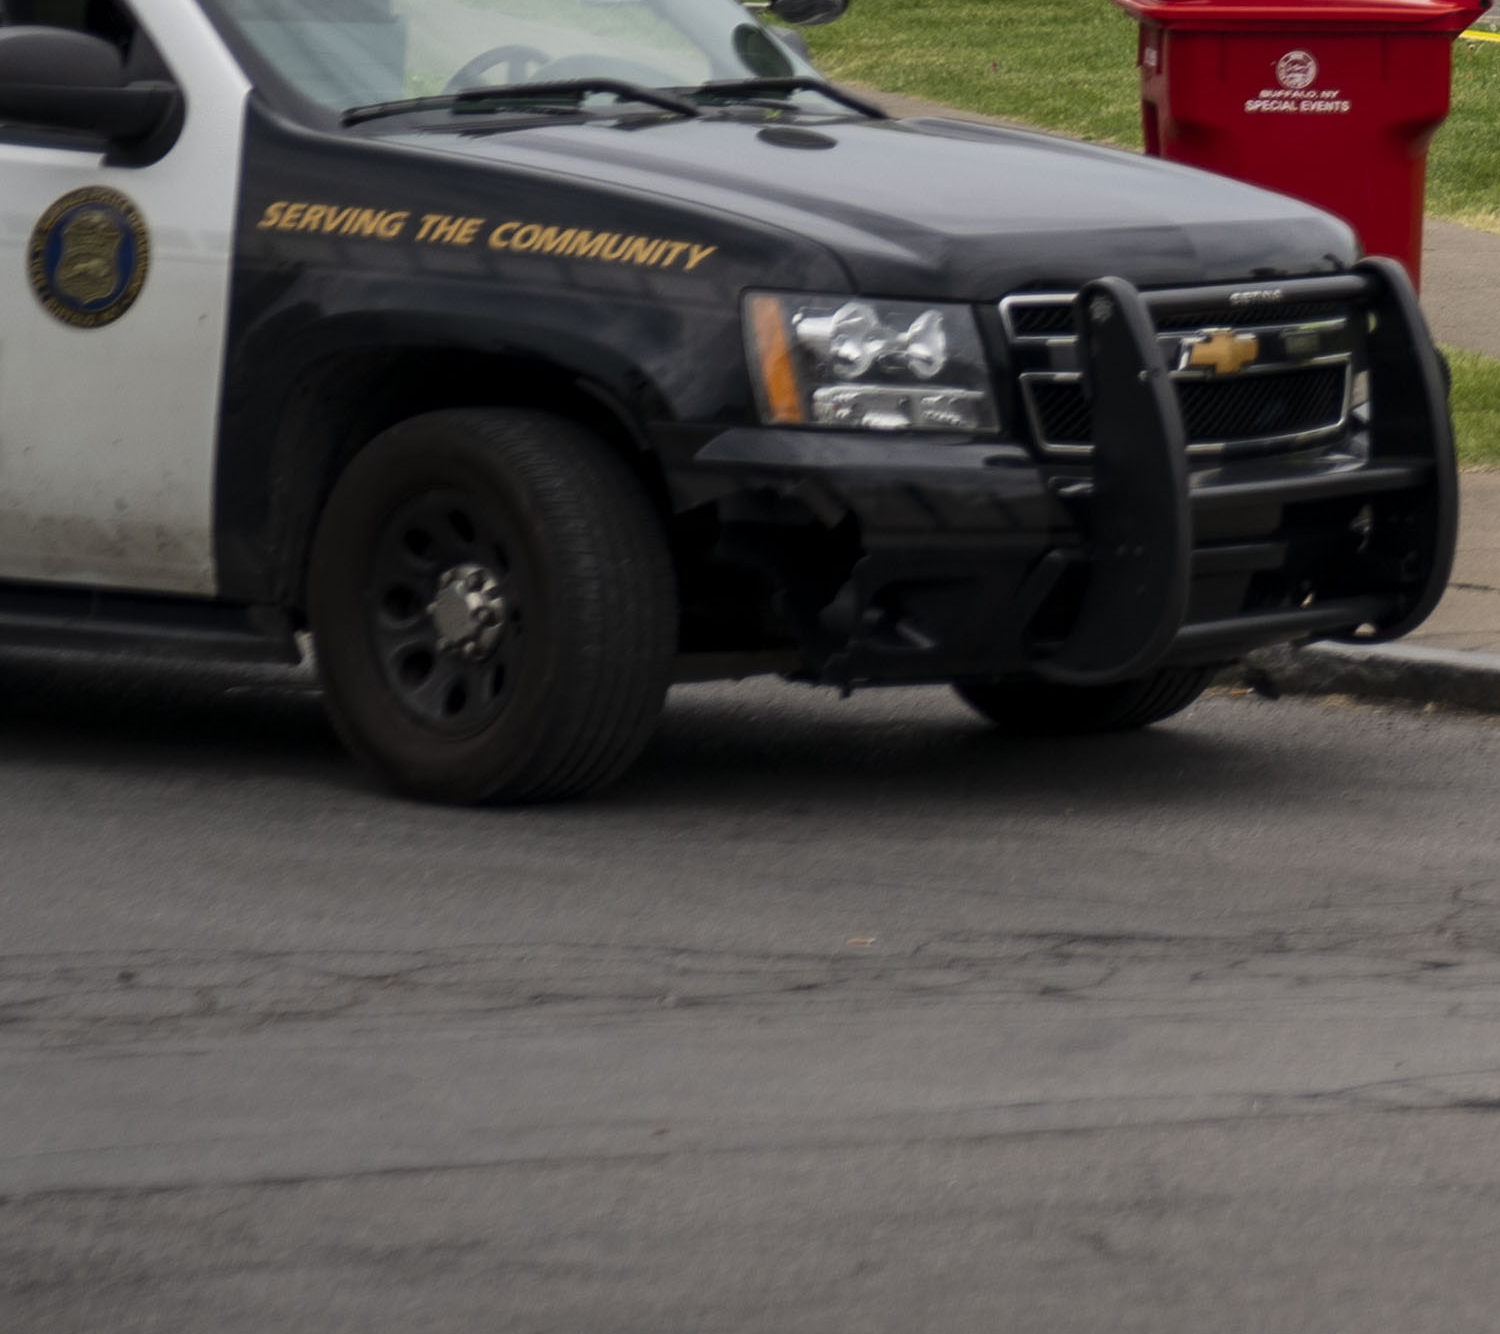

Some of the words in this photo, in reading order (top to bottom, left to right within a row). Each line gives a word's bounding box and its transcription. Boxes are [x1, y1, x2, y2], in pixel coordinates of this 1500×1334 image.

[1244, 100, 1299, 112] SPECIAL
[1300, 100, 1352, 112] EVENTS
[257, 201, 410, 238] SERVING
[414, 214, 485, 246] THE
[488, 221, 718, 271] COMMUNITY
